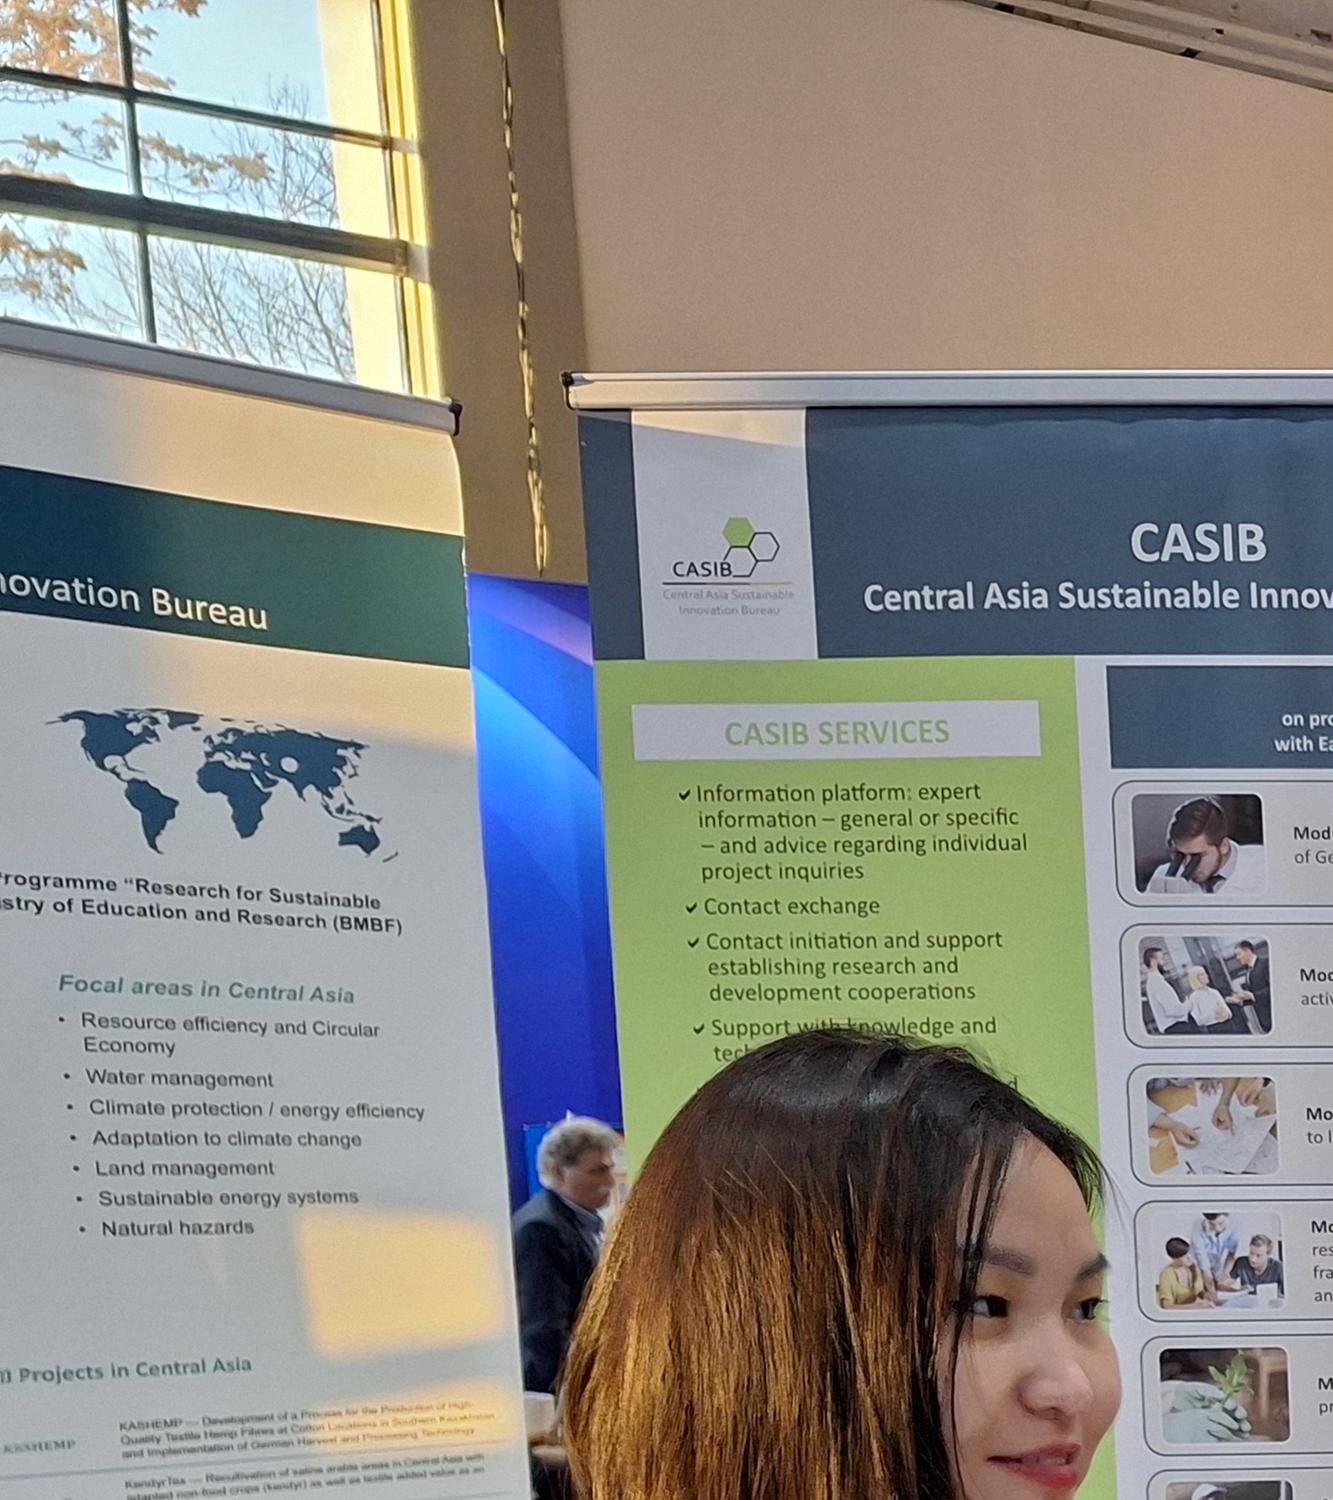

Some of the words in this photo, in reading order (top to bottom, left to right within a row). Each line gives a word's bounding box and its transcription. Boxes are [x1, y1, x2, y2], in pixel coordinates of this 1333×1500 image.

[1131, 522, 1267, 563] CASIB
[672, 560, 733, 578] CASIB
[662, 588, 704, 601] Central
[705, 589, 729, 601] Asia
[730, 589, 795, 601] Sustainable
[864, 581, 974, 612] Central
[983, 580, 1049, 610] Asia
[1058, 579, 1240, 609] Sustainable
[151, 587, 268, 630] Bureau
[678, 605, 739, 616] Innovation
[740, 604, 781, 616] Bureau
[1281, 713, 1305, 727] on
[724, 721, 810, 746] CASIB
[818, 719, 950, 746] SERVICES
[1274, 734, 1314, 752] with
[696, 783, 816, 803] Information
[821, 782, 912, 806] platform:
[918, 783, 982, 805] expert
[698, 809, 817, 829] information
[840, 807, 913, 832] general
[919, 812, 940, 827] or
[945, 806, 1020, 831] specific
[720, 835, 757, 854] and
[763, 835, 827, 854] advice
[833, 834, 927, 858] regarding
[932, 832, 1027, 853] individual
[1294, 848, 1311, 865] of
[701, 862, 773, 885] project
[778, 861, 865, 884] inquiries
[236, 885, 263, 902] for
[269, 887, 381, 910] Sustainable
[704, 897, 782, 916] Contact
[787, 896, 880, 918] exchange
[706, 932, 784, 951] Contact
[789, 931, 878, 950] initiation
[884, 930, 920, 949] and
[926, 931, 1004, 953] support
[58, 974, 124, 994] Focal
[131, 981, 193, 997] areas
[200, 980, 221, 998] in
[228, 981, 305, 1002] Central
[309, 986, 355, 1004] Asia
[81, 1011, 177, 1031] Resource
[182, 1015, 268, 1038] efficiency
[274, 1020, 307, 1036] and
[312, 1020, 380, 1038] Circular
[83, 1036, 176, 1058] Economy
[85, 1067, 146, 1085] Water
[151, 1073, 274, 1091] management
[89, 1098, 166, 1116] Climate
[171, 1101, 263, 1120] protection
[279, 1105, 340, 1122] energy
[345, 1102, 425, 1122] efficiency
[19, 1365, 105, 1385] Projects
[110, 1362, 130, 1379] in
[135, 1357, 207, 1378] Central
[212, 1356, 252, 1374] Asia
